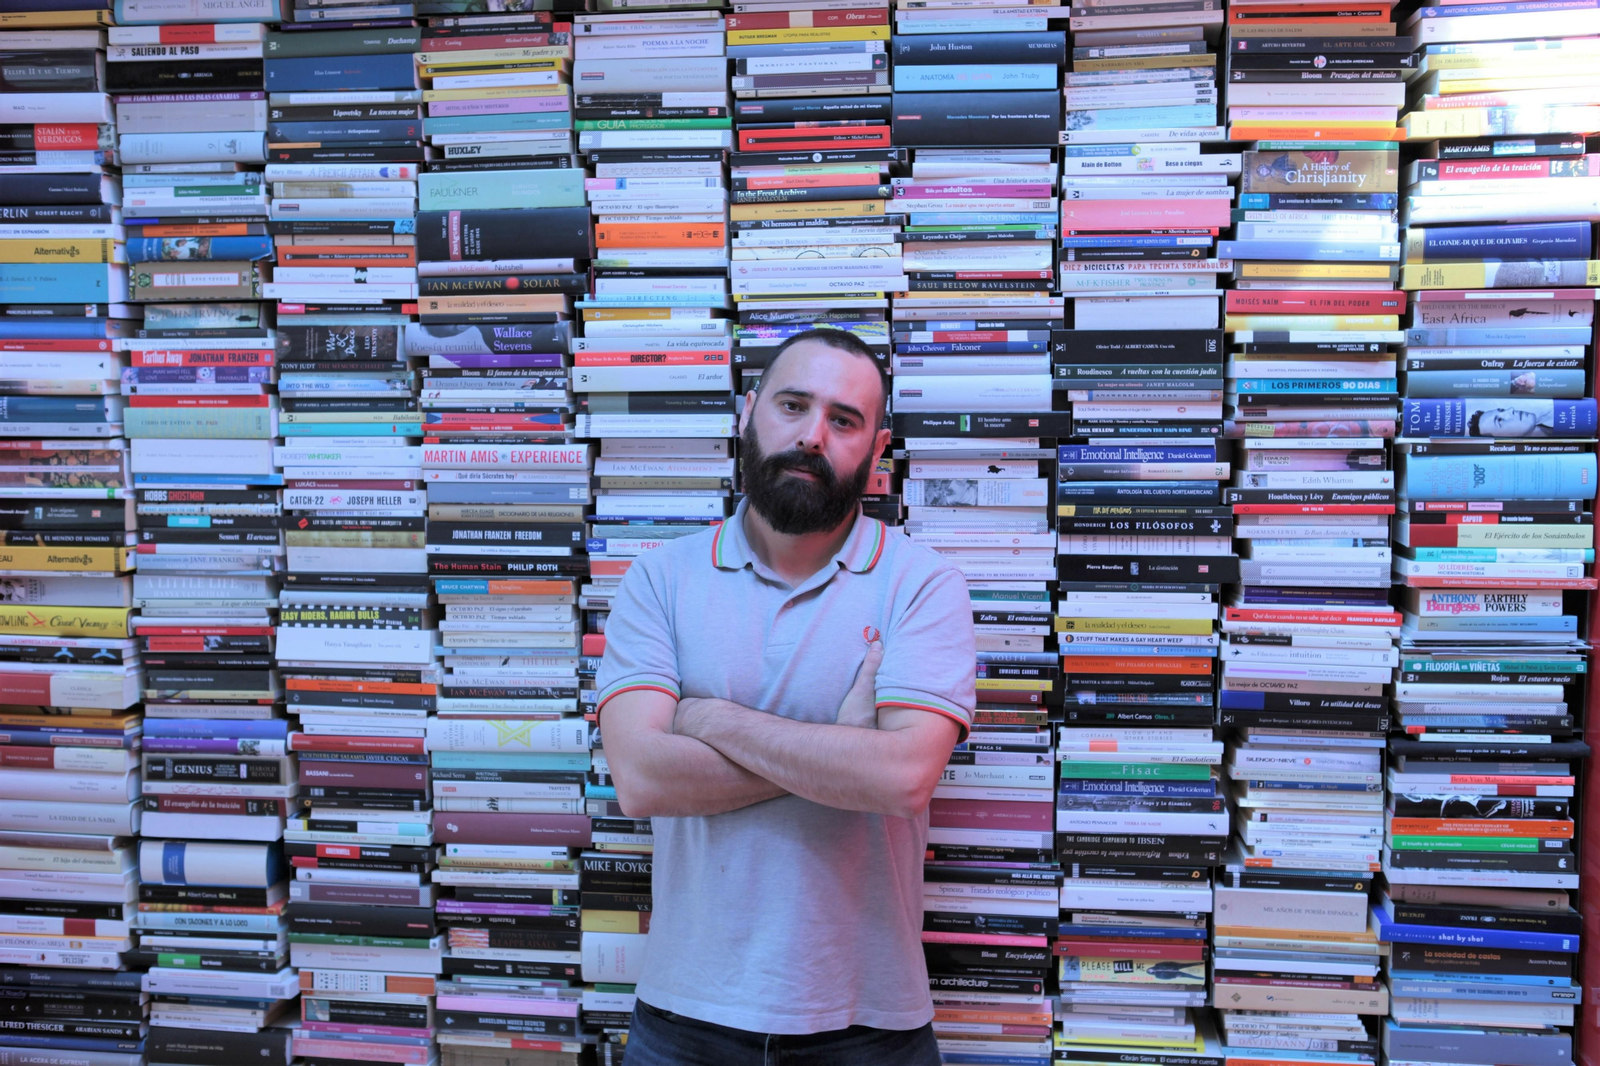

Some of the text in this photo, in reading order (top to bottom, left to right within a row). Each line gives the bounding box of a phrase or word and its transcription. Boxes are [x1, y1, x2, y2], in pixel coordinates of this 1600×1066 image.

[388, 37, 416, 45] Duchamp
[131, 46, 200, 56] SALIENDO AL PASO
[1021, 72, 1040, 81] Truby
[1330, 72, 1359, 80] Presagios
[597, 119, 626, 130] GUÍA
[38, 128, 65, 136] STALIN
[448, 146, 482, 155] HUXLEY
[1184, 160, 1202, 168] ciegas
[1311, 163, 1339, 172] History
[1454, 165, 1490, 176] evangelio
[1286, 170, 1366, 187] Christianity
[430, 187, 478, 196] FAULKNER
[777, 188, 807, 196] Archives
[428, 282, 447, 290] IAN
[524, 279, 560, 288] SOLAR
[1422, 314, 1486, 324] East Africa
[494, 327, 532, 338] Wallace
[411, 341, 482, 352] Poesía reunida
[494, 340, 532, 350] Stevens
[142, 351, 259, 366] Farther Away JONATHAN FRANZEN
[630, 354, 666, 363] DIRECTOR?
[1523, 359, 1545, 368] fuerza
[424, 450, 498, 463] MARTIN AMIS
[510, 450, 582, 464] EXPERIENCE
[1080, 450, 1120, 460] Emotional
[1124, 449, 1164, 462] Intelligence
[144, 491, 204, 502] HOBBS GHOSTMAN
[290, 496, 324, 505] CATCH-22
[347, 496, 402, 506] JOSEPH HELLER
[1136, 520, 1194, 530] FILÓSOFOS
[452, 530, 542, 540] JONATHAN FRANZEN FREEDOM
[1494, 532, 1517, 541] Ejército
[481, 563, 502, 571] Stain
[1431, 594, 1478, 602] ANTHONY
[1484, 594, 1528, 604] EARTHLY
[1426, 601, 1480, 613] Burgess
[1485, 604, 1526, 612] POWERS
[281, 611, 380, 622] EASY RIDERS, RAGING BULLS
[1426, 662, 1460, 672] FILOSOFÍA
[1470, 662, 1500, 672] VIÑETAS
[174, 765, 212, 774] GENIUS
[1122, 766, 1160, 776] Fisac
[584, 860, 610, 872] MIKE
[1004, 952, 1046, 960] Encyclopédie
[1082, 962, 1146, 972] PLEASE KILL ME
[26, 1022, 64, 1032] THESIGER
